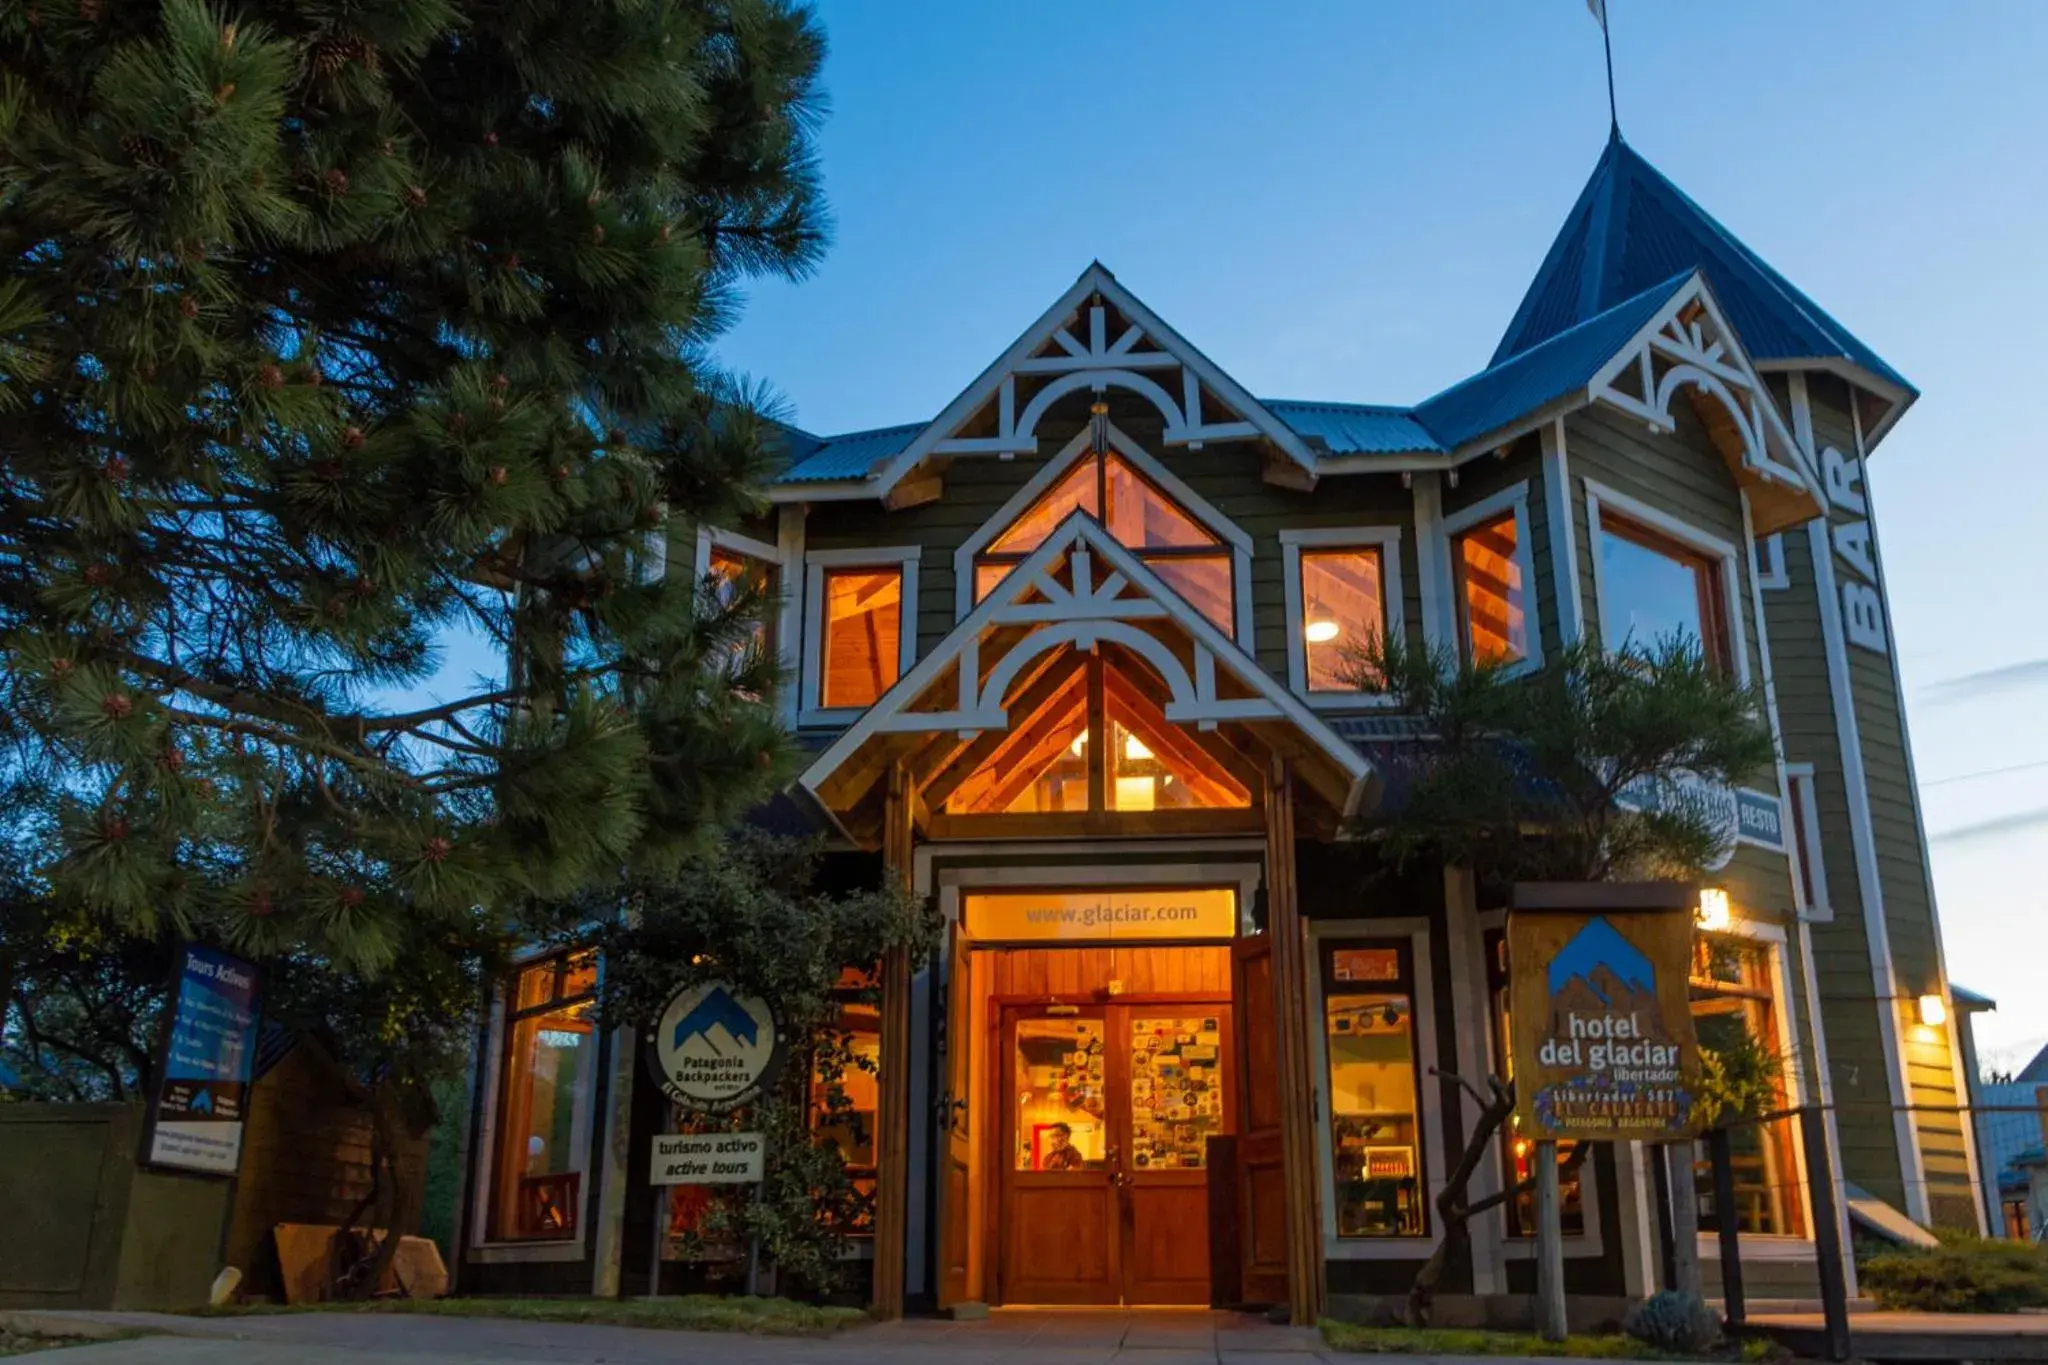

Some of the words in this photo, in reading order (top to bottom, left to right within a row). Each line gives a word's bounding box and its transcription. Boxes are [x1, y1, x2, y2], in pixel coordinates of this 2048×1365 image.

[1823, 446, 1888, 655] BAR
[1741, 803, 1778, 834] RESTO
[1026, 904, 1198, 926] www.glaciar.com
[186, 952, 215, 978] Tours
[1569, 1012, 1640, 1038] hotel
[1540, 1039, 1582, 1065] del
[1589, 1039, 1679, 1069] glaciar
[684, 1055, 744, 1070] Patagonia
[676, 1071, 750, 1084] Backpackers
[1614, 1068, 1680, 1082] libertador
[1553, 1089, 1636, 1102] Libertador
[1555, 1101, 1574, 1116] EL
[659, 1141, 711, 1155] turismo
[716, 1140, 758, 1152] activo
[666, 1160, 707, 1175] active
[712, 1160, 748, 1174] tours
